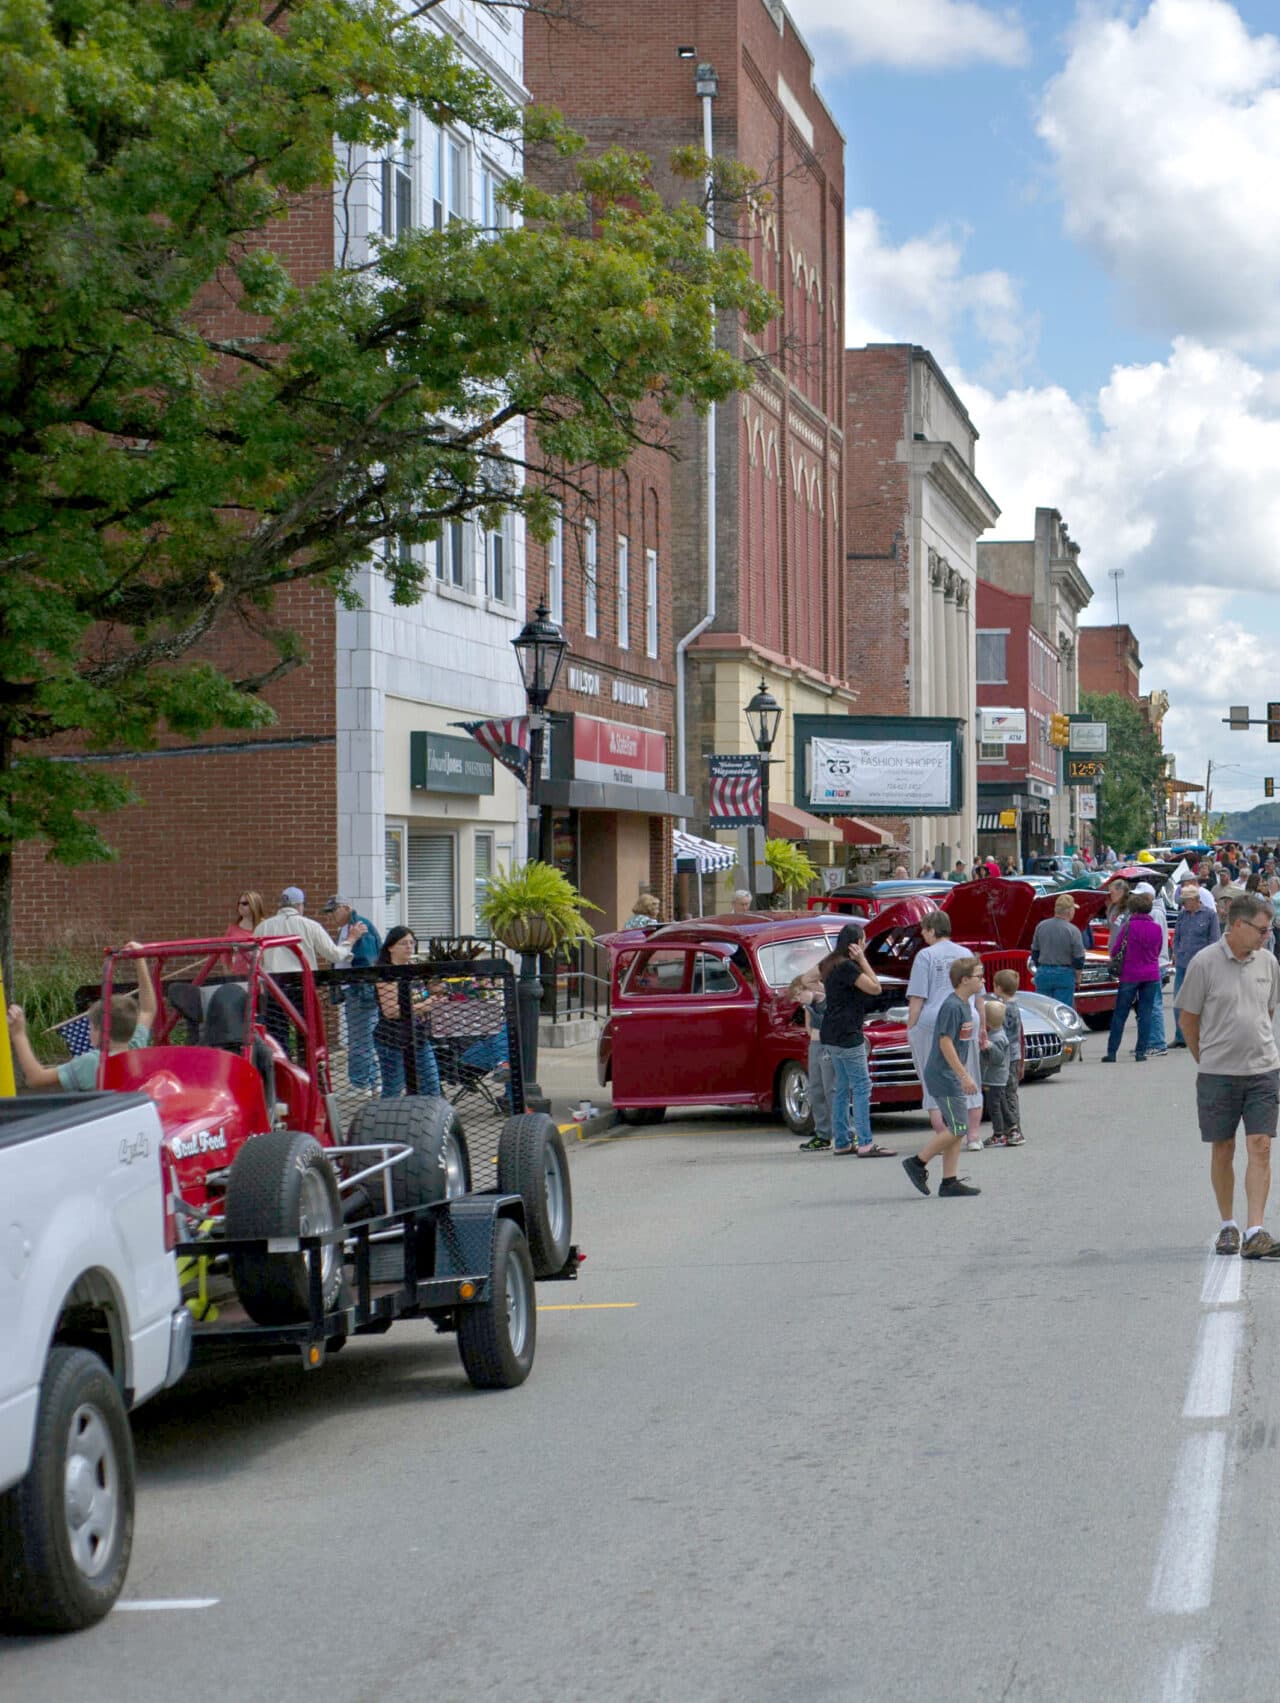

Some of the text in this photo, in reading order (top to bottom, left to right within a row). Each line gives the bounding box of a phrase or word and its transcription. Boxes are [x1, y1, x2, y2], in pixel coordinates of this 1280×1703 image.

[568, 667, 600, 697] WILSON
[1008, 733, 1022, 741] ATM
[826, 758, 851, 774] 75
[860, 756, 943, 768] FASHION SHOPPE
[171, 1126, 227, 1160] Soul Food
